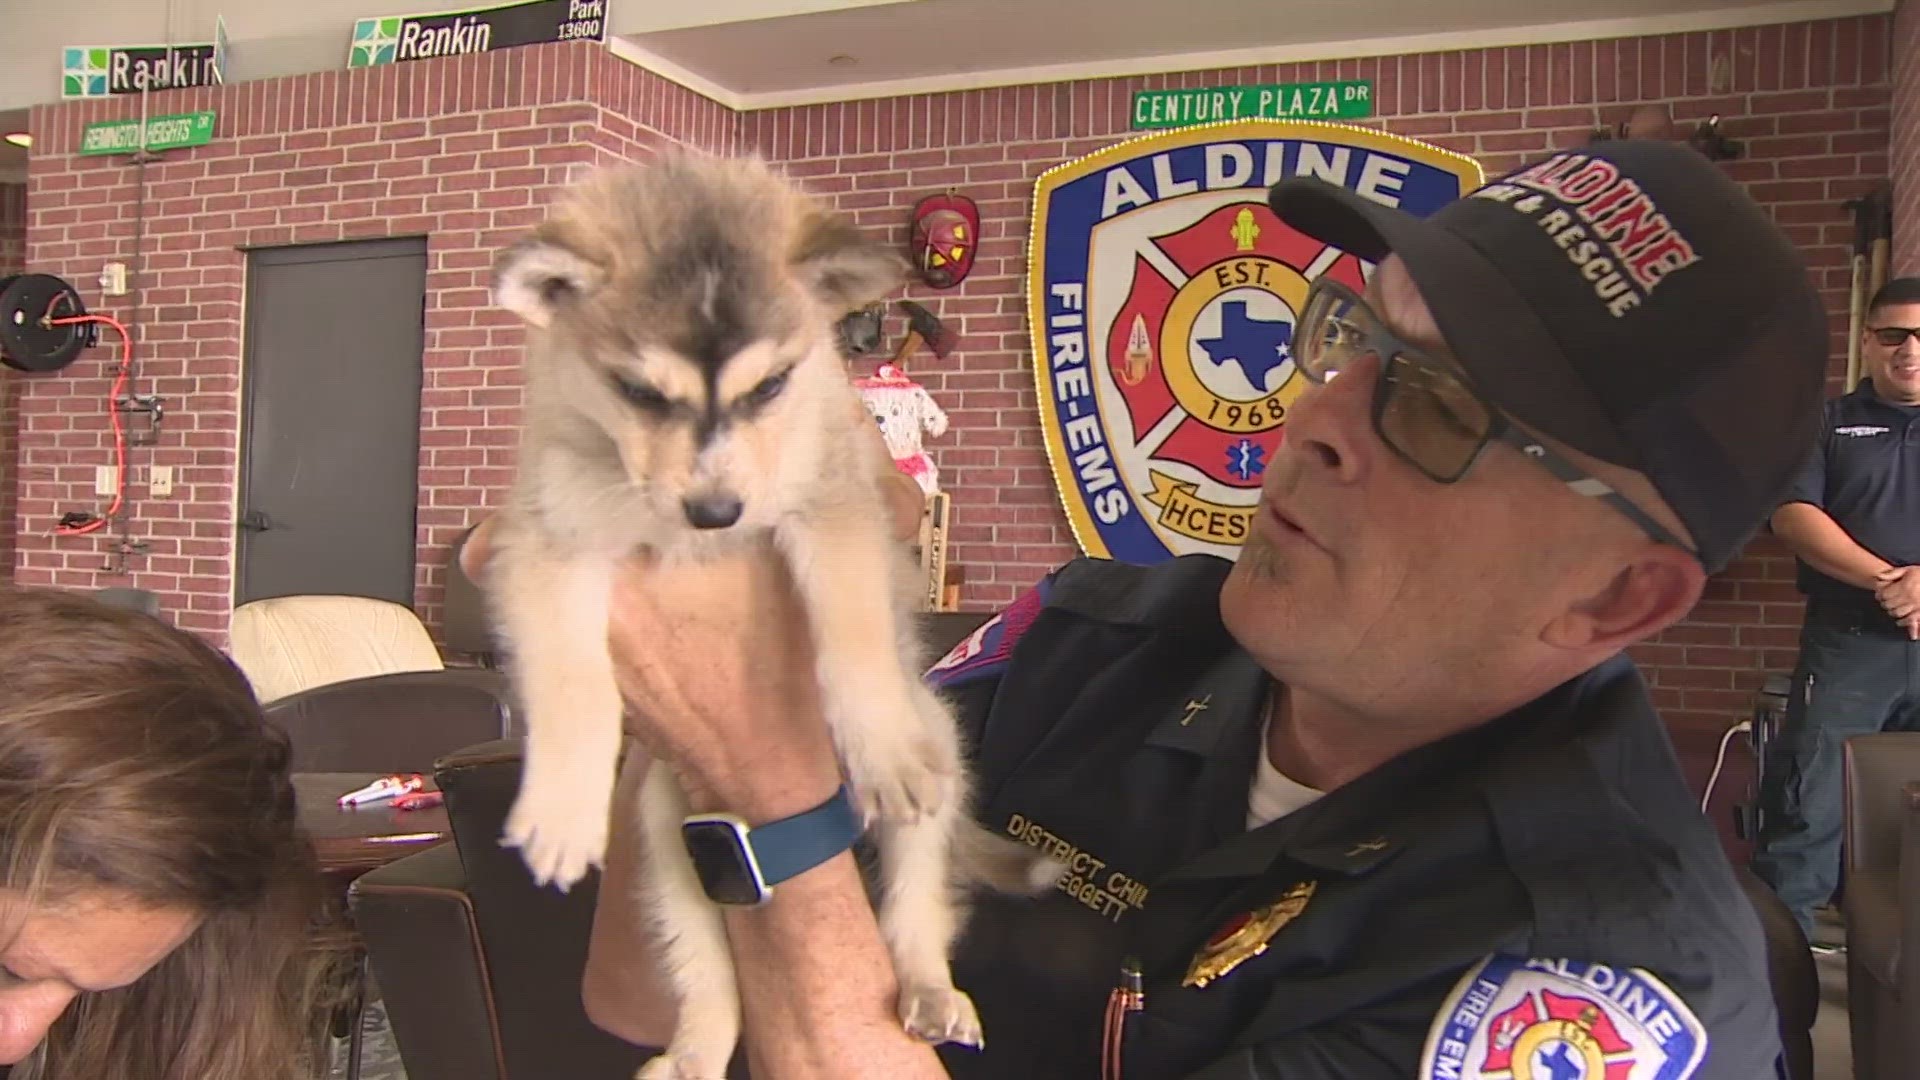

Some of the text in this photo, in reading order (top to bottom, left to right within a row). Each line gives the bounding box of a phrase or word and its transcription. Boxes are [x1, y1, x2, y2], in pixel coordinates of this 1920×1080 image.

[558, 20, 599, 39] 13600
[569, 0, 602, 20] Park
[401, 16, 491, 58] Rankin
[113, 50, 216, 89] Rankin
[1135, 85, 1369, 123] CENTURY PLAZA DR
[1101, 141, 1410, 220] ALDINE
[1503, 153, 1702, 294] ALDINE
[1214, 261, 1271, 288] EST.
[1537, 208, 1641, 318] RESCUE
[1050, 282, 1129, 525] FIRE-EMS
[1207, 397, 1285, 427] 1968
[1006, 813, 1106, 879] DISTRICT
[1055, 871, 1129, 922] EGGETT
[1434, 978, 1500, 1080] FIRE-EM
